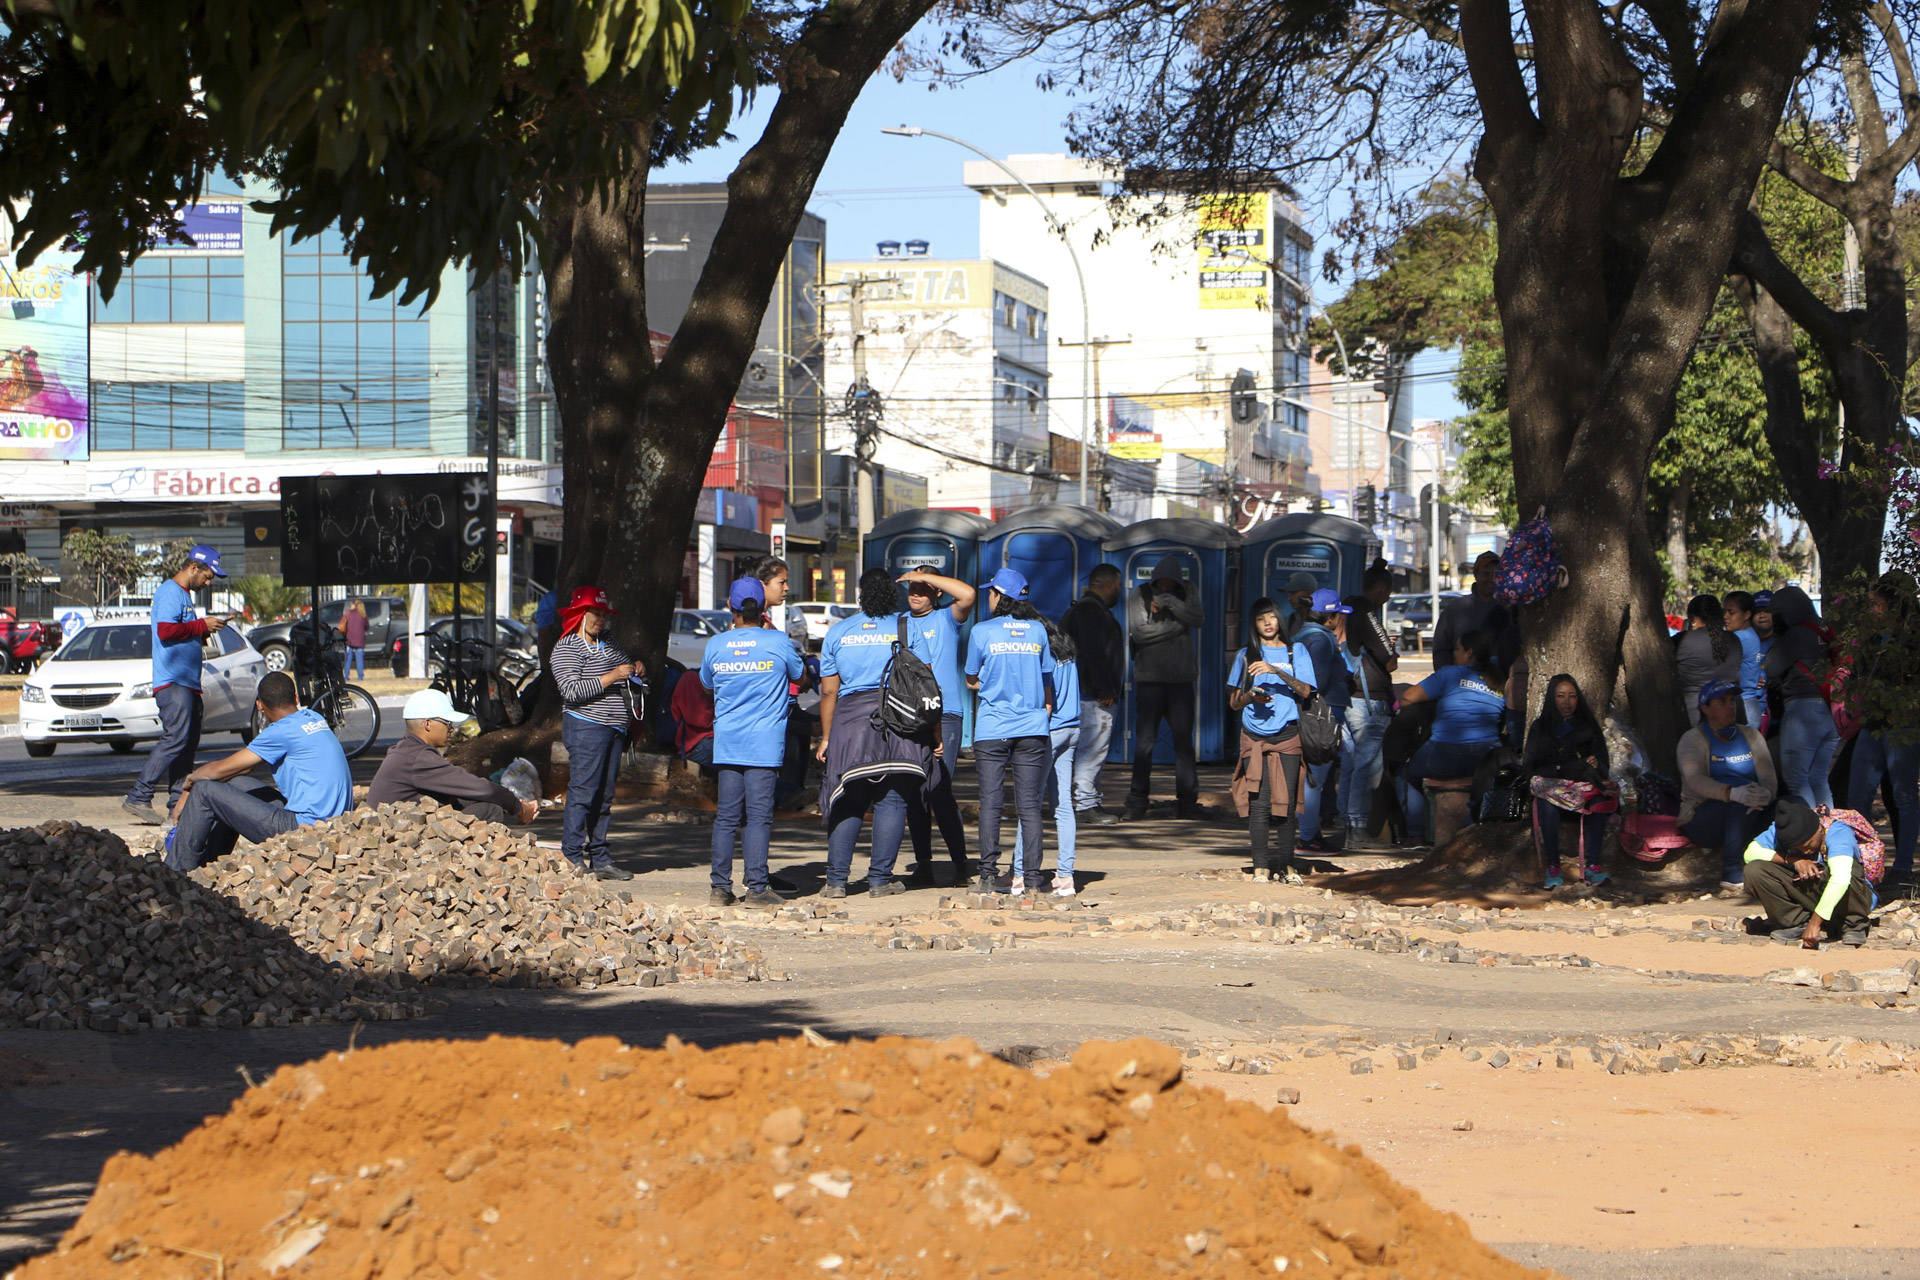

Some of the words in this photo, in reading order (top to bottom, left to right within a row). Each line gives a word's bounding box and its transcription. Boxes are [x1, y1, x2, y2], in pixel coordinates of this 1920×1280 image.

[153, 469, 261, 496] Fábrica
[902, 558, 940, 566] FEMININO
[1278, 560, 1327, 569] MASCULINO
[726, 640, 757, 648] ALUNO
[713, 660, 774, 672] RENOVADF
[80, 715, 99, 726] 8691
